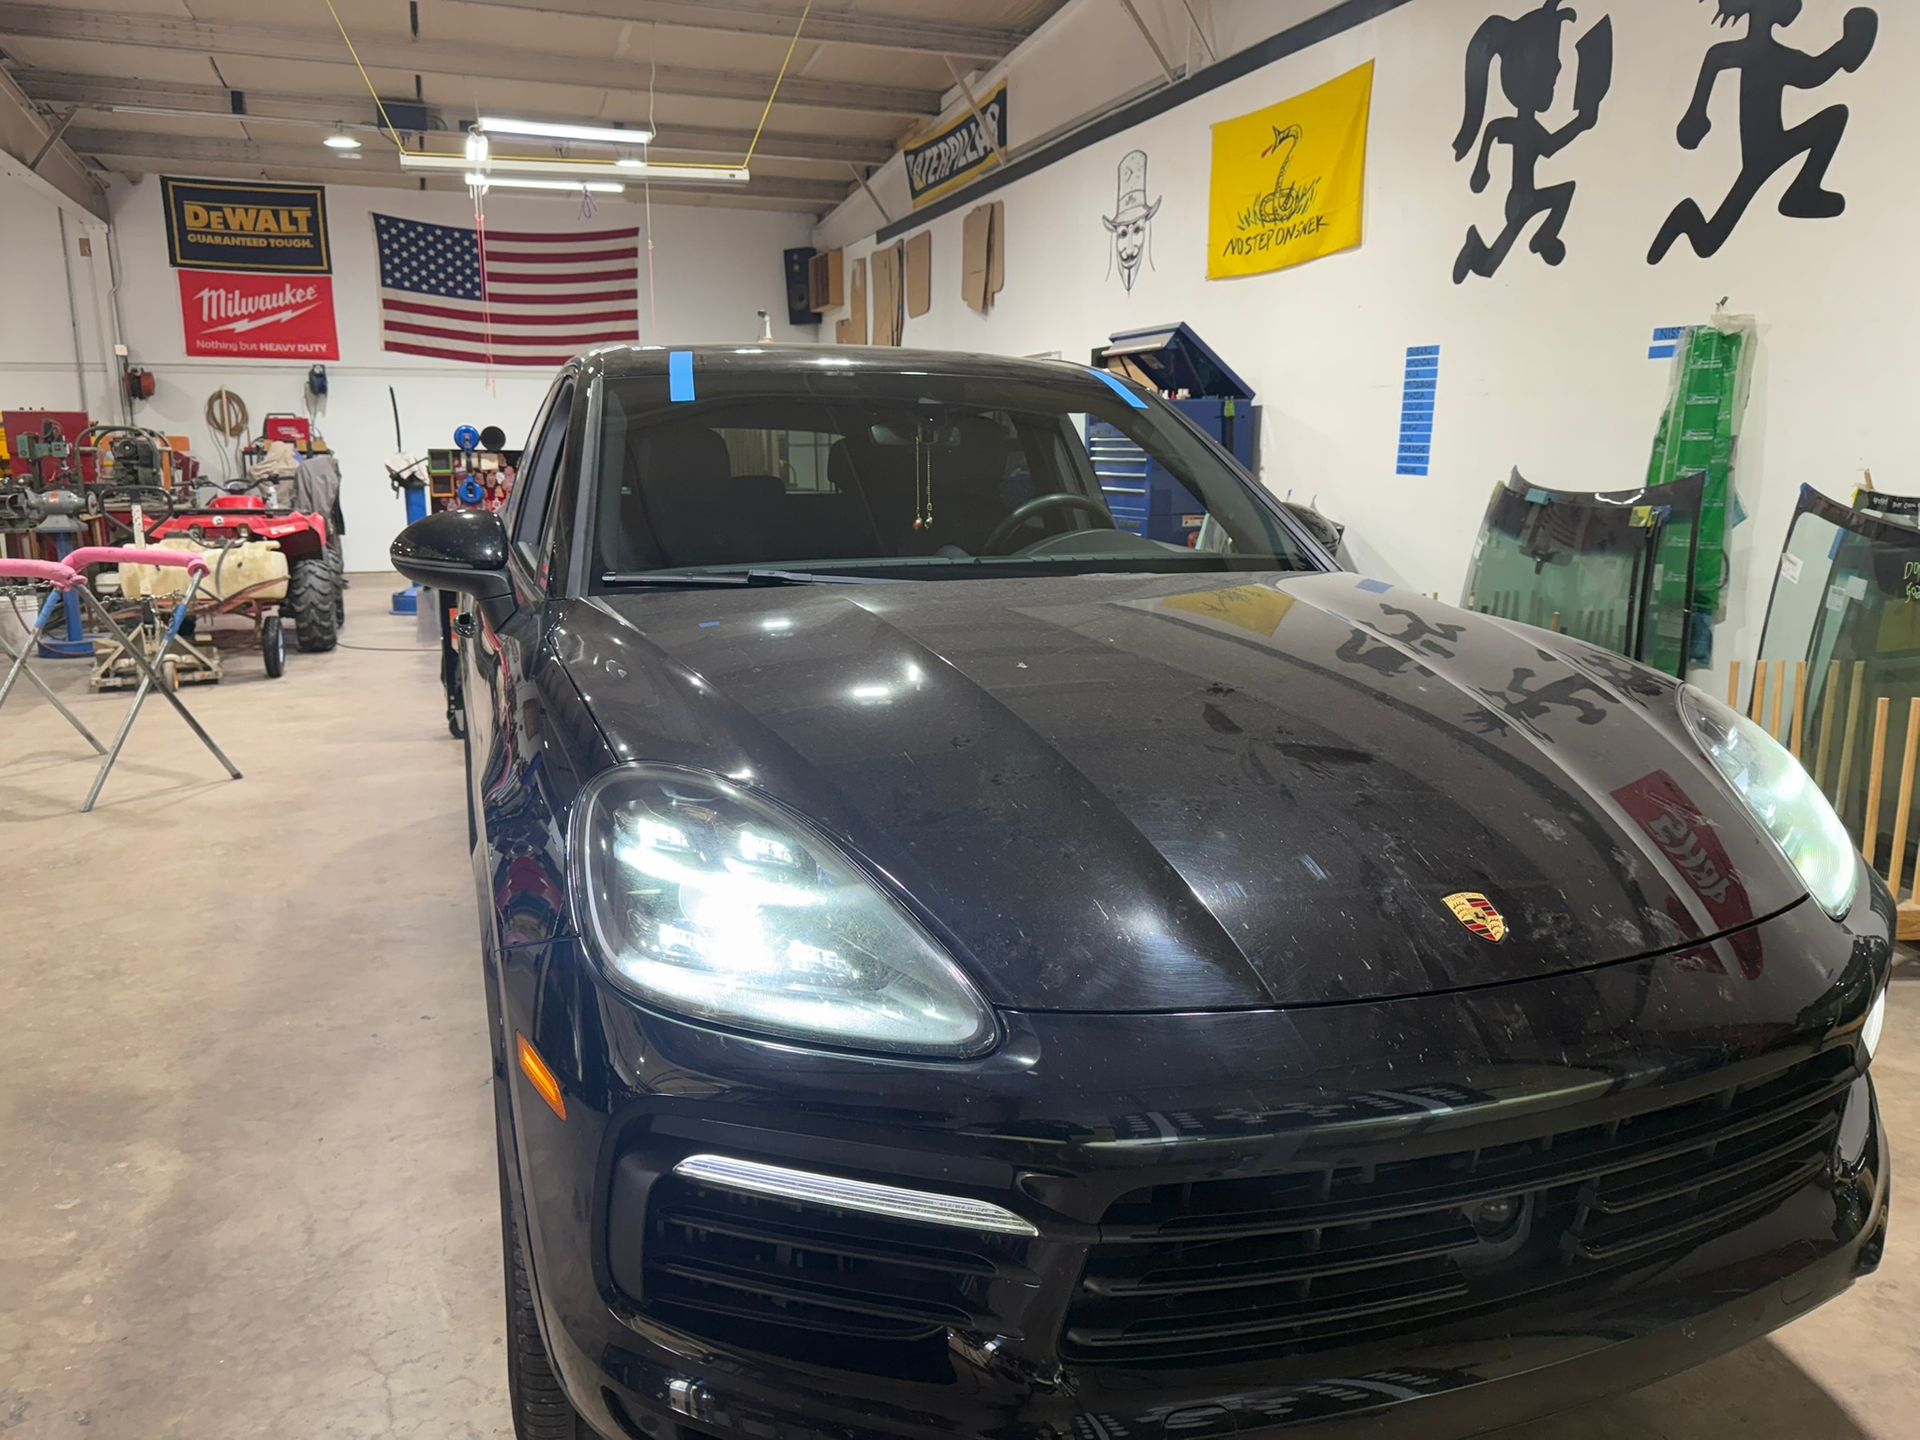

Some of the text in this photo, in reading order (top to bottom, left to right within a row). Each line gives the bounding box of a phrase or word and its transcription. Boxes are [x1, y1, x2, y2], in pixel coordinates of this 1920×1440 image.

[183, 203, 312, 234] DEWALT
[187, 234, 314, 249] GUARANTEED TOUGH.
[1222, 237, 1244, 256] NO
[1245, 229, 1275, 255] STEP
[1275, 224, 1296, 246] ON
[192, 283, 318, 323] Milwaukee
[196, 339, 328, 353] Nothing but HEAVY DUTY
